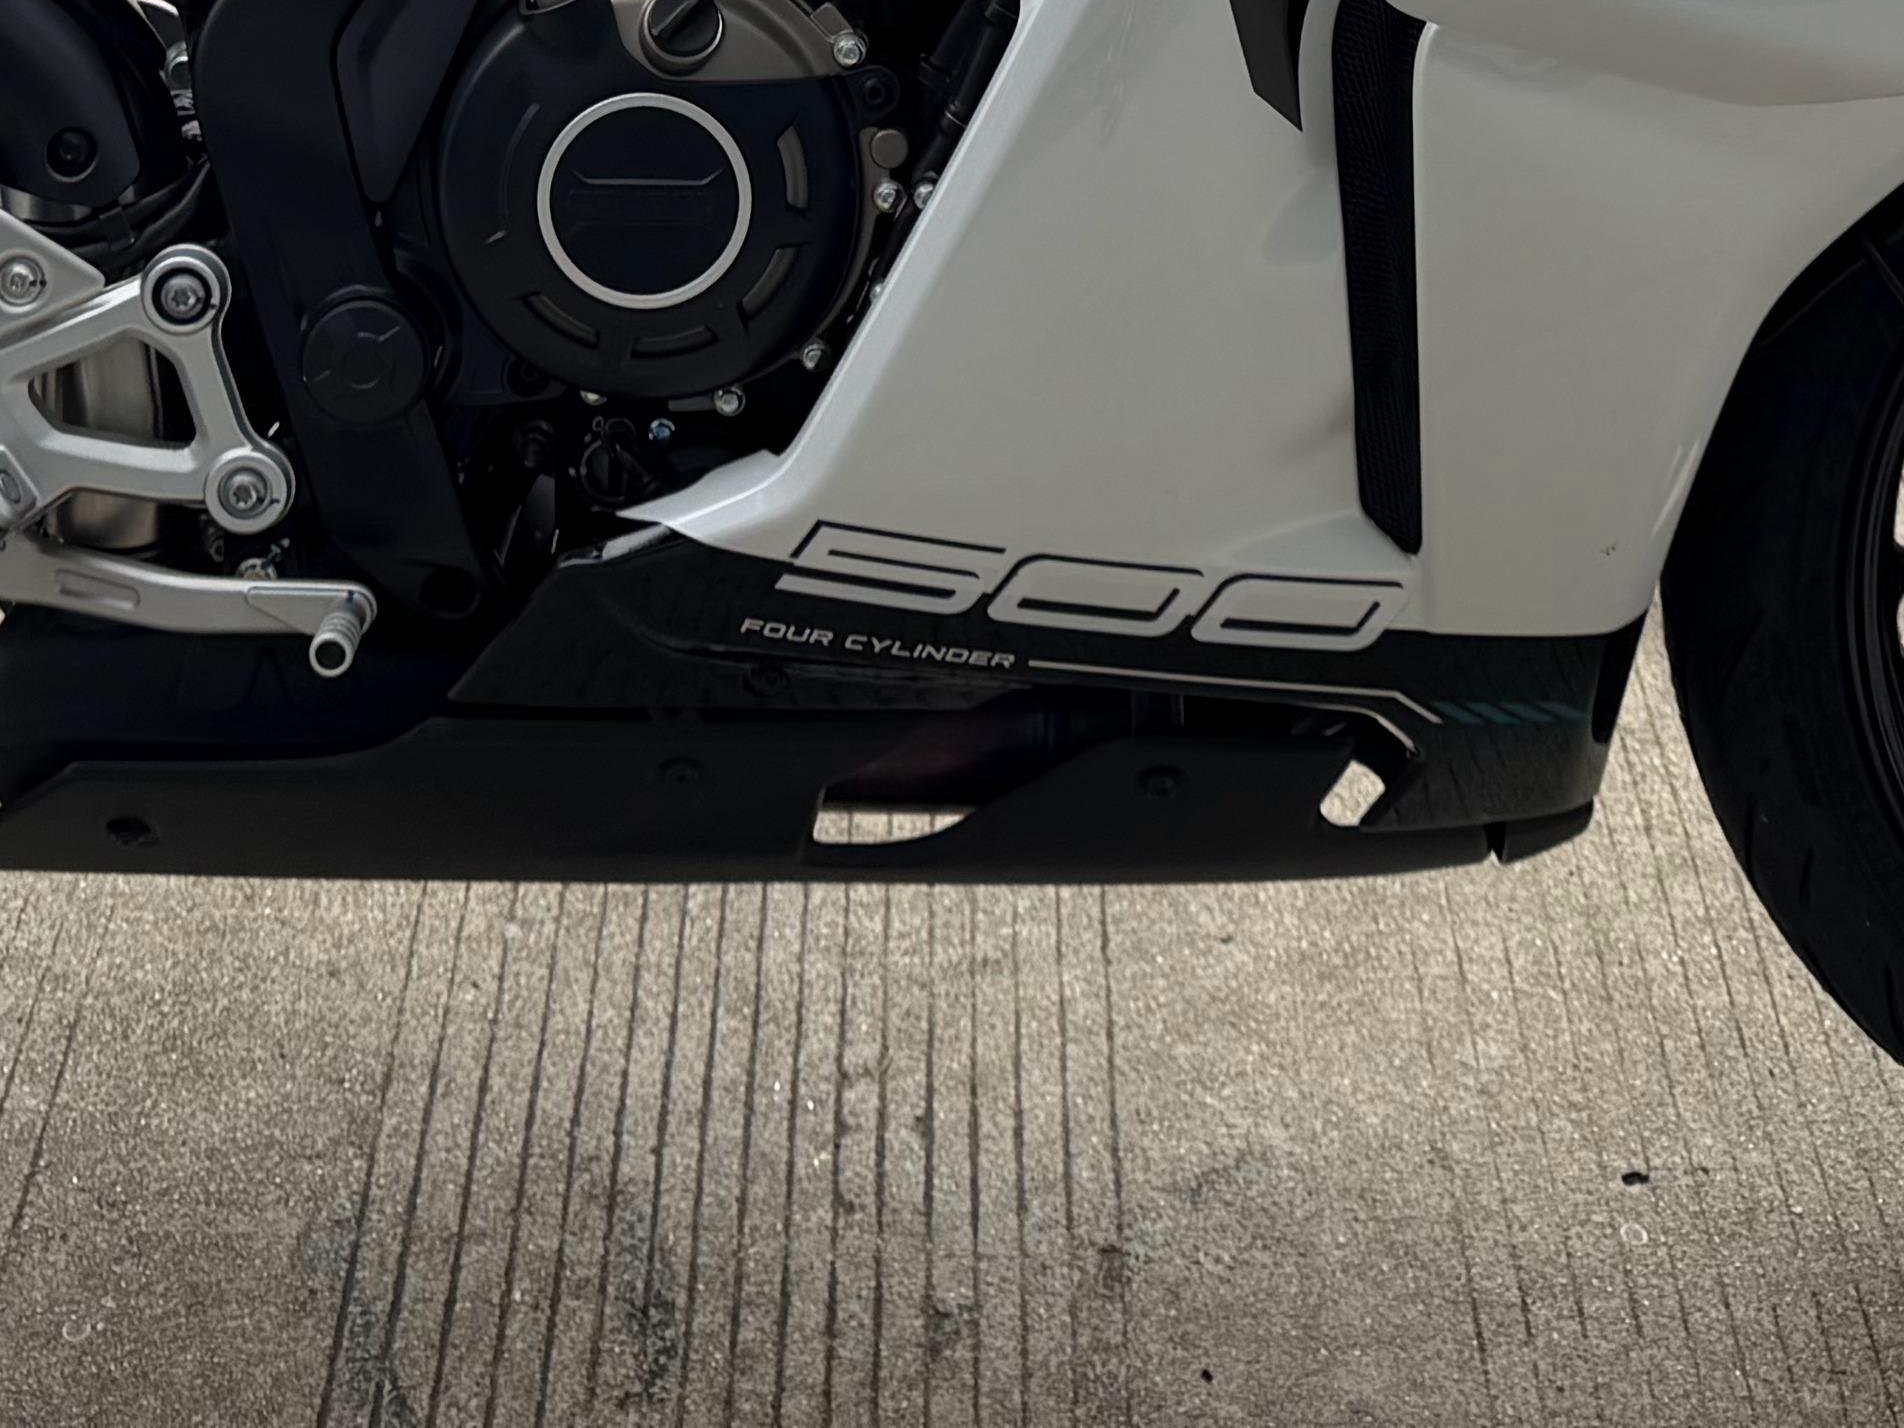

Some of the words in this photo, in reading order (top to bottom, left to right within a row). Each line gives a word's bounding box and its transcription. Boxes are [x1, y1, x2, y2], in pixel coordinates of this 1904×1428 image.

[774, 519, 1409, 653] 500
[741, 617, 835, 646] FOUR
[844, 634, 1016, 669] CYLINDER
